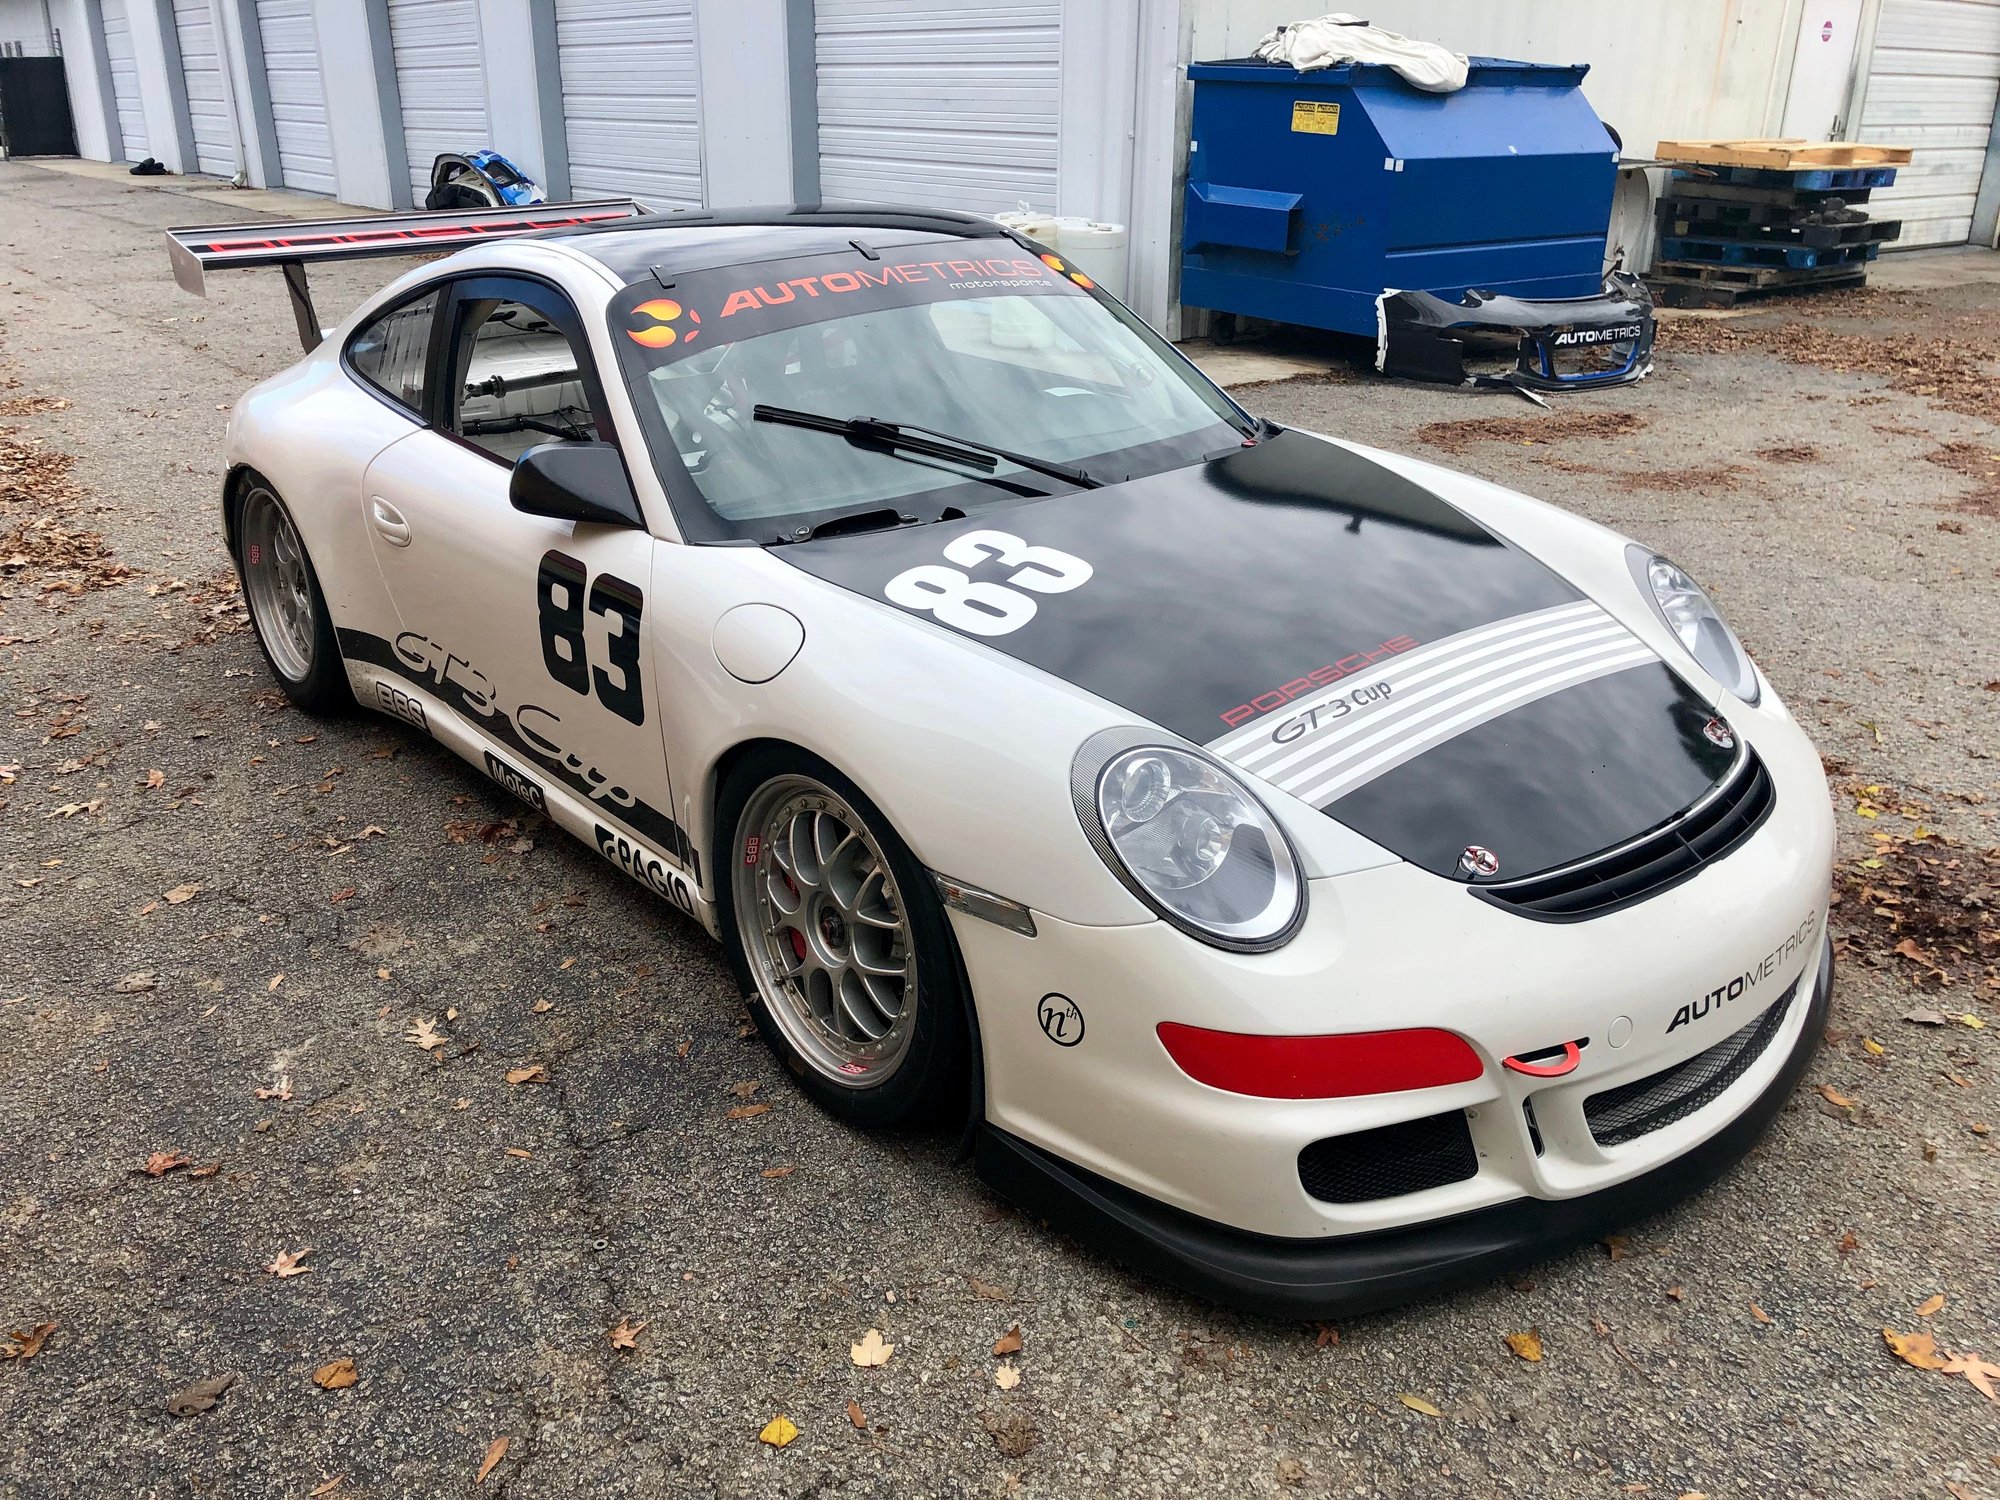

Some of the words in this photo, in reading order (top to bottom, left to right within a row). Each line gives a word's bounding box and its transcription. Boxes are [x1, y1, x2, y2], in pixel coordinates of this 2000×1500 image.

[720, 259, 1042, 318] AUTOMETRICS
[949, 279, 1053, 290] motorsports
[1554, 325, 1640, 345] AUTOMETRICS
[251, 545, 260, 564] BBS
[884, 529, 1094, 637] 83
[537, 549, 645, 727] 83
[376, 681, 431, 734] BBS
[1219, 634, 1420, 728] PORSCHE
[1351, 681, 1392, 706] Cup
[390, 631, 497, 718] GT3
[508, 703, 638, 810] Cup
[491, 759, 542, 810] MoTeC
[746, 837, 759, 863] BBS
[1665, 910, 1816, 1035] AUTOMETRICS
